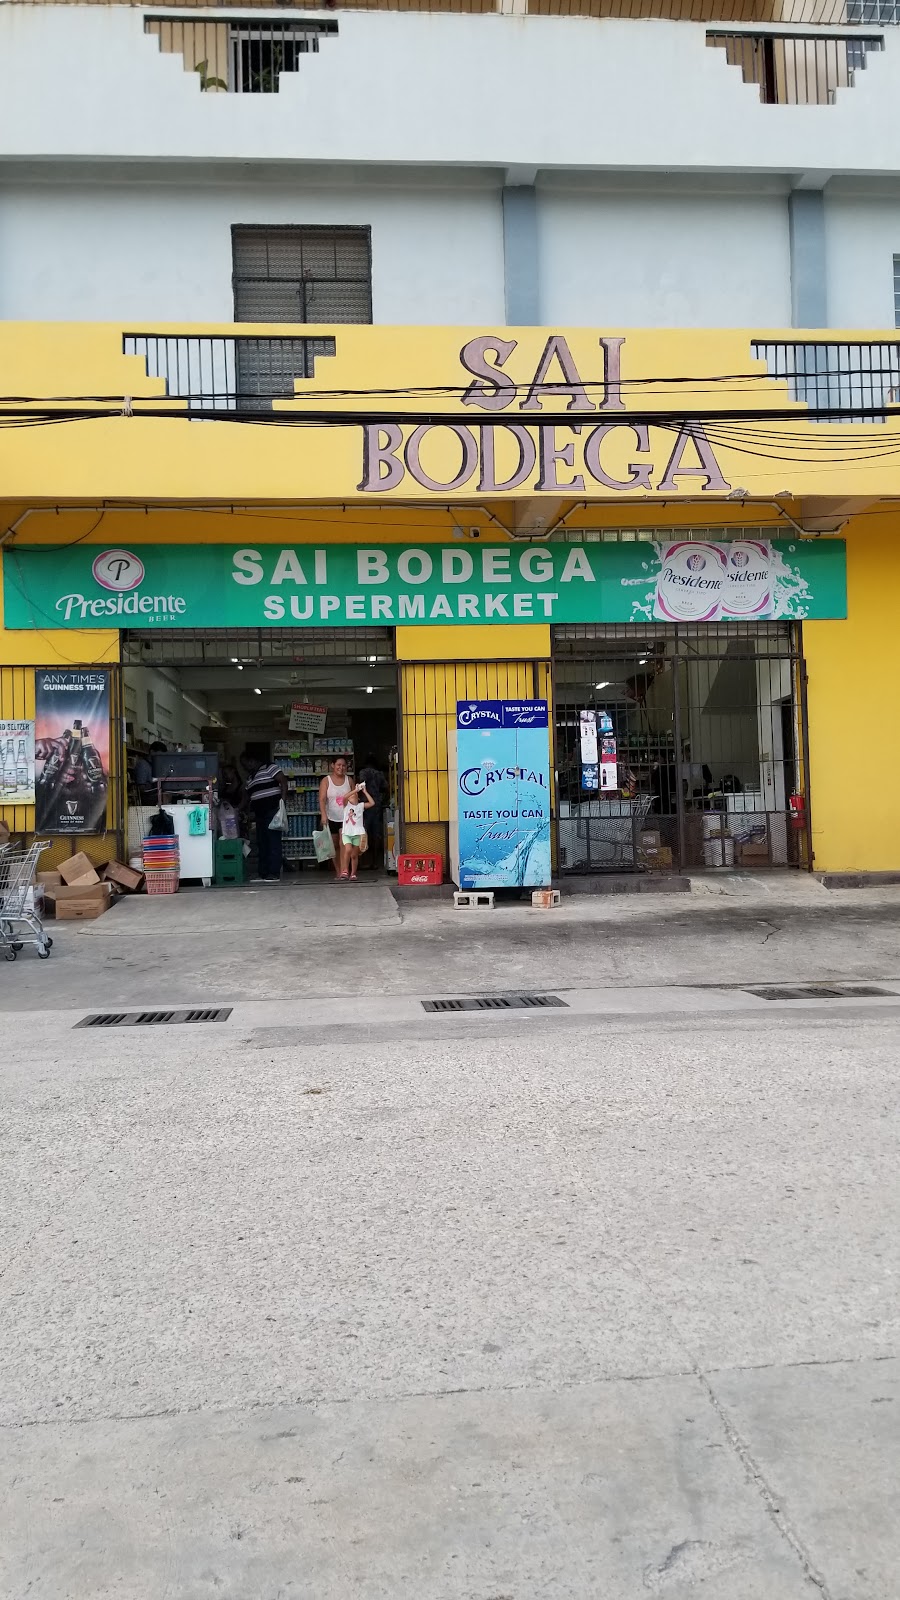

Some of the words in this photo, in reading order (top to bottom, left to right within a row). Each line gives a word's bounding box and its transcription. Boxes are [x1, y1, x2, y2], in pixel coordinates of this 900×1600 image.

[459, 335, 627, 411] SAI
[356, 416, 732, 492] BODEGA
[231, 548, 328, 586] SAI
[356, 547, 597, 586] BODEGA
[726, 570, 769, 582] sidente
[663, 567, 724, 590] Presidente
[55, 592, 187, 621] Presidente
[263, 592, 559, 621] SUPERMARKET
[148, 614, 177, 623] BEER
[43, 674, 68, 684] ANY
[70, 674, 105, 684] TIME'S
[43, 683, 84, 691] GUINNESS
[85, 683, 105, 691] TIME
[7, 723, 30, 731] SELTZER
[458, 709, 501, 726] CRYSTAL
[511, 712, 546, 724] Trust
[459, 766, 548, 796] CRYSTAL
[463, 809, 493, 819] TASTE
[495, 809, 519, 819] YOU
[521, 809, 543, 818] CAN
[475, 820, 536, 843] Trust
